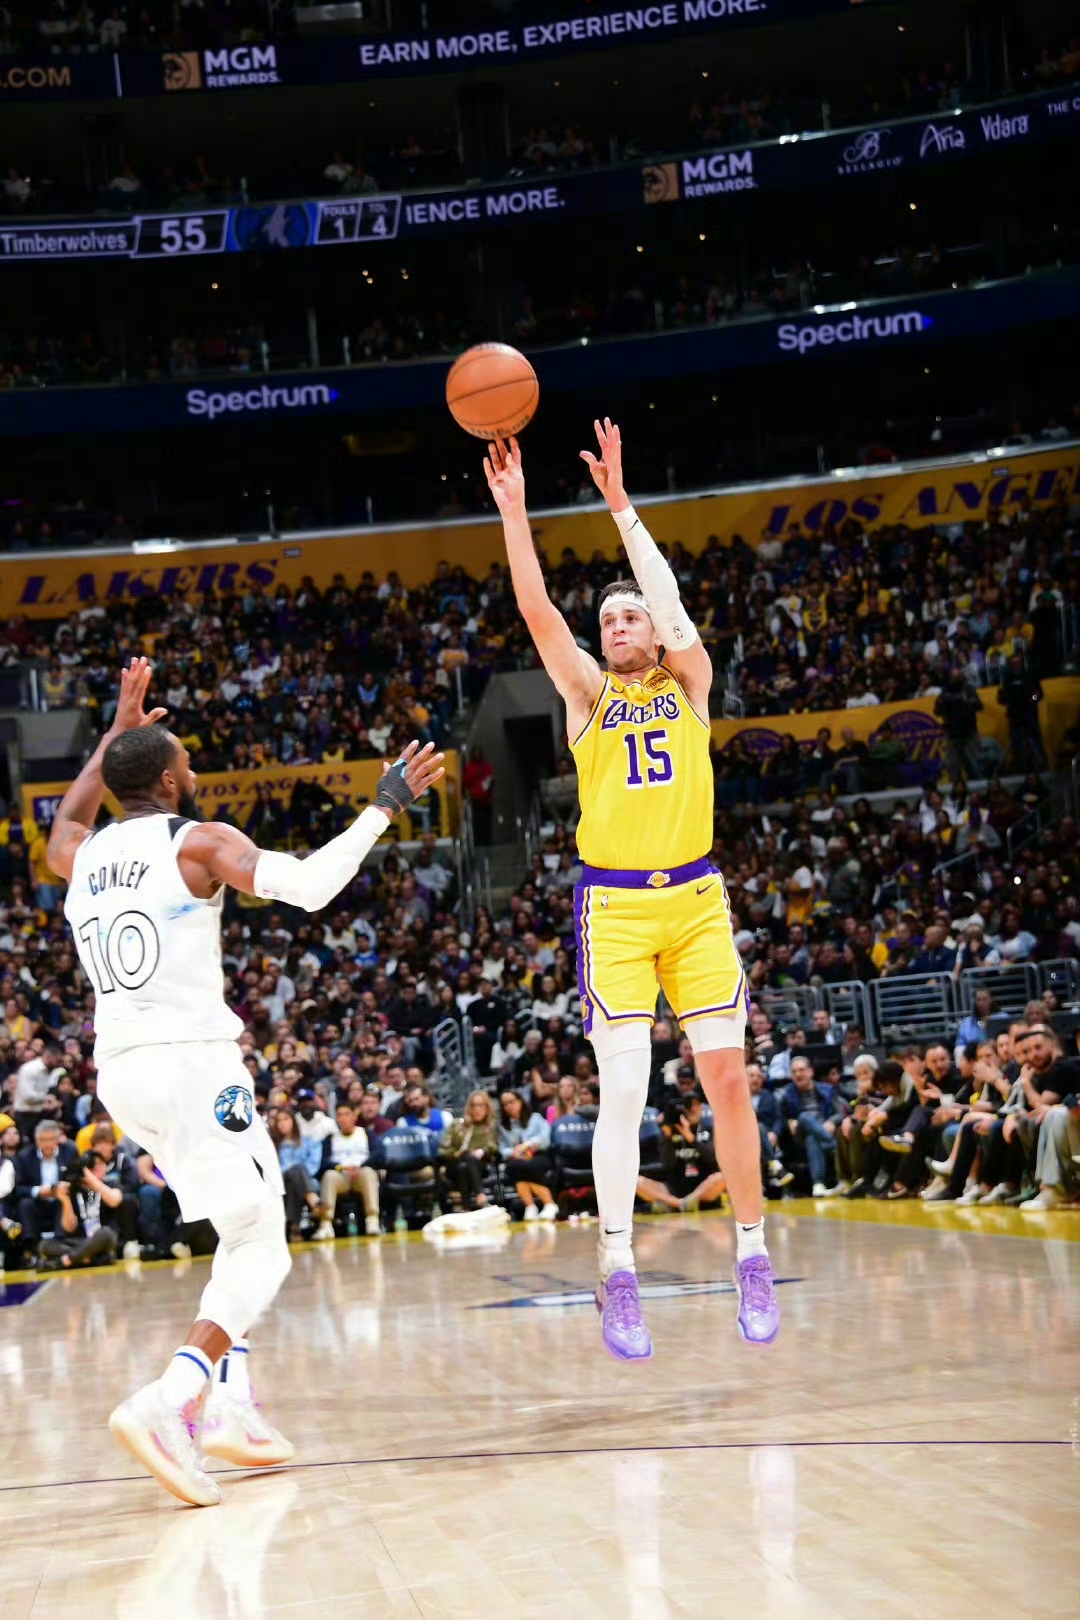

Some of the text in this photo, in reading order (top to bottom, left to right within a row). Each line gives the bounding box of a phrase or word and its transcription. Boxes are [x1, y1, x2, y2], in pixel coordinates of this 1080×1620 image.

[360, 0, 767, 65] EARN MORE, EXPERIENCE MORE.
[204, 45, 277, 73] MGM
[1047, 100, 1070, 116] THE
[919, 122, 967, 158] Aria
[980, 112, 1030, 142] Vdara
[682, 150, 754, 184] MGM
[406, 187, 566, 225] IENCE MORE.
[1, 229, 128, 254] Timberwolves
[160, 217, 208, 252] 55
[333, 217, 346, 239] 1
[371, 213, 388, 237] 4
[778, 311, 923, 354] Spectrum
[187, 384, 330, 419] Spectrum
[765, 493, 885, 535] LOS
[19, 560, 279, 605] LAKERS
[601, 692, 680, 730] LAKERS
[624, 729, 675, 787] 15
[88, 860, 150, 897] CONLEY
[78, 909, 160, 995] 10
